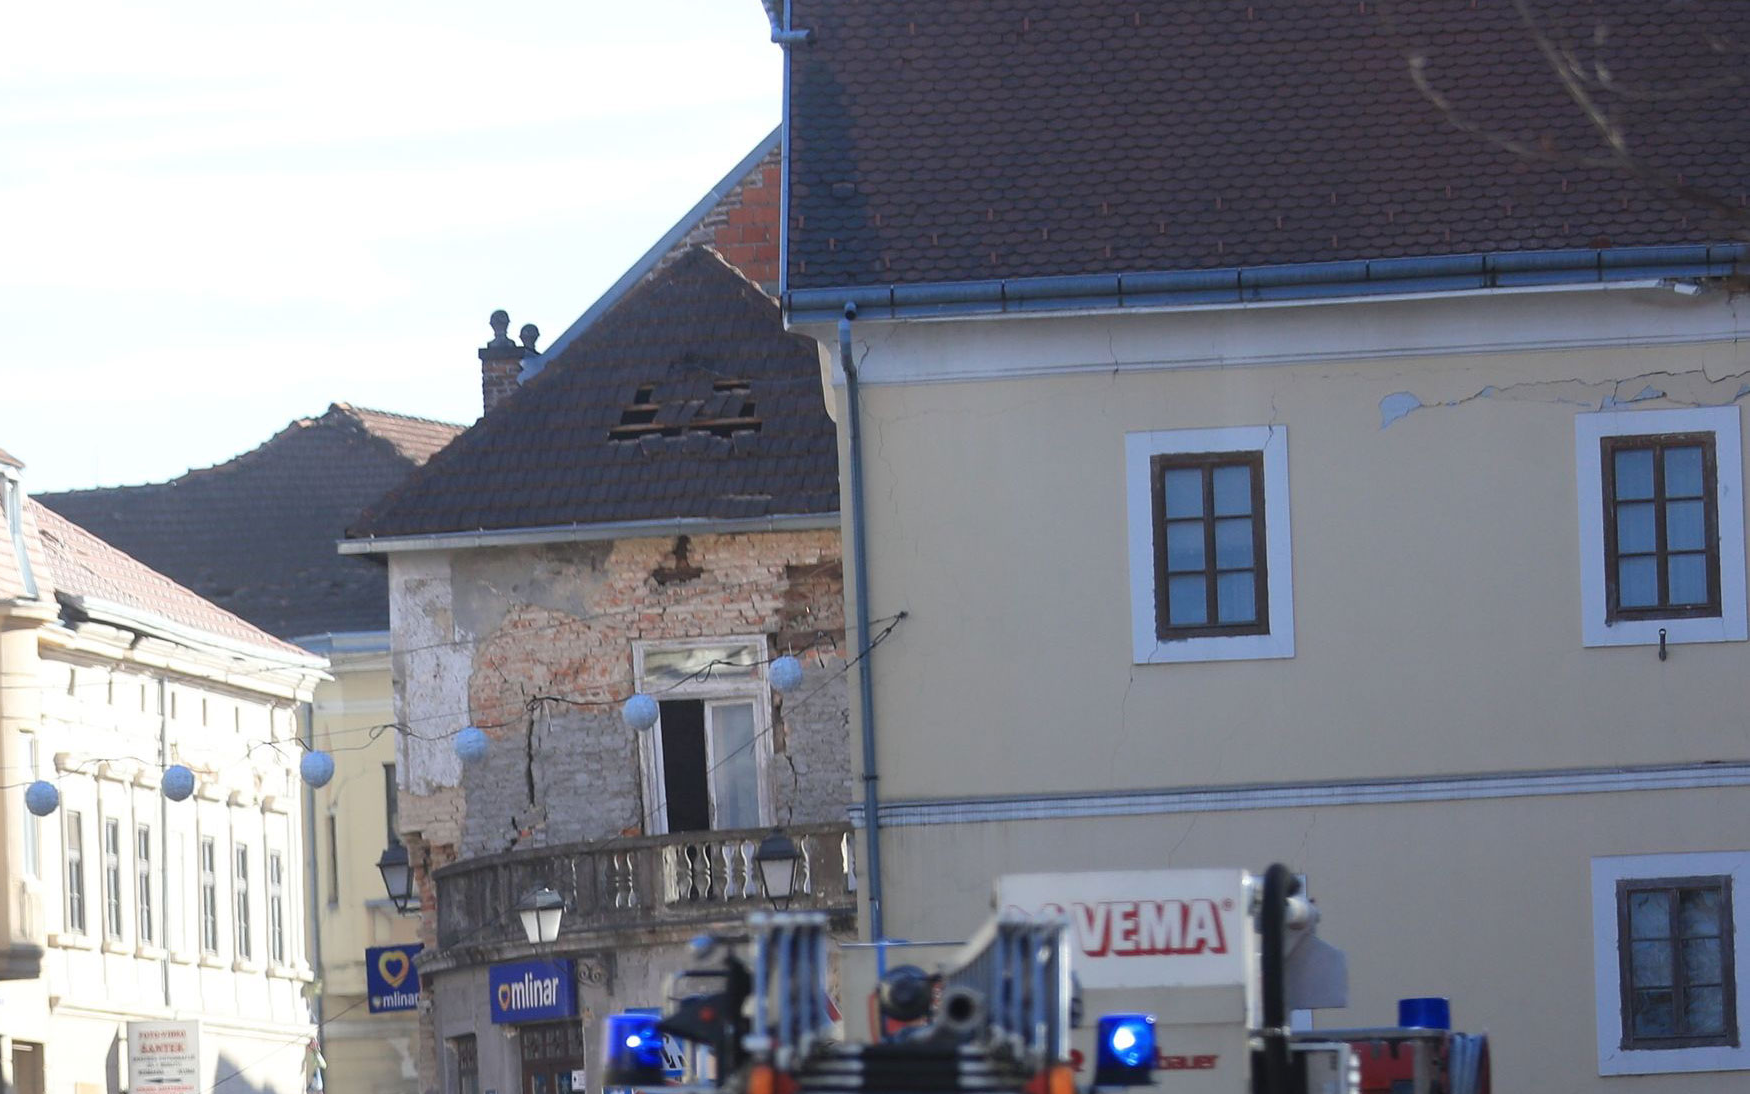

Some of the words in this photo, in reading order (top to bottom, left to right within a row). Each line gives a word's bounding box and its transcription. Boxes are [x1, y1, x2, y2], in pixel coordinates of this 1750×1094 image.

[1007, 899, 1227, 957] VEMA
[511, 972, 559, 1010] mlinar
[1156, 1047, 1218, 1070] bauer
